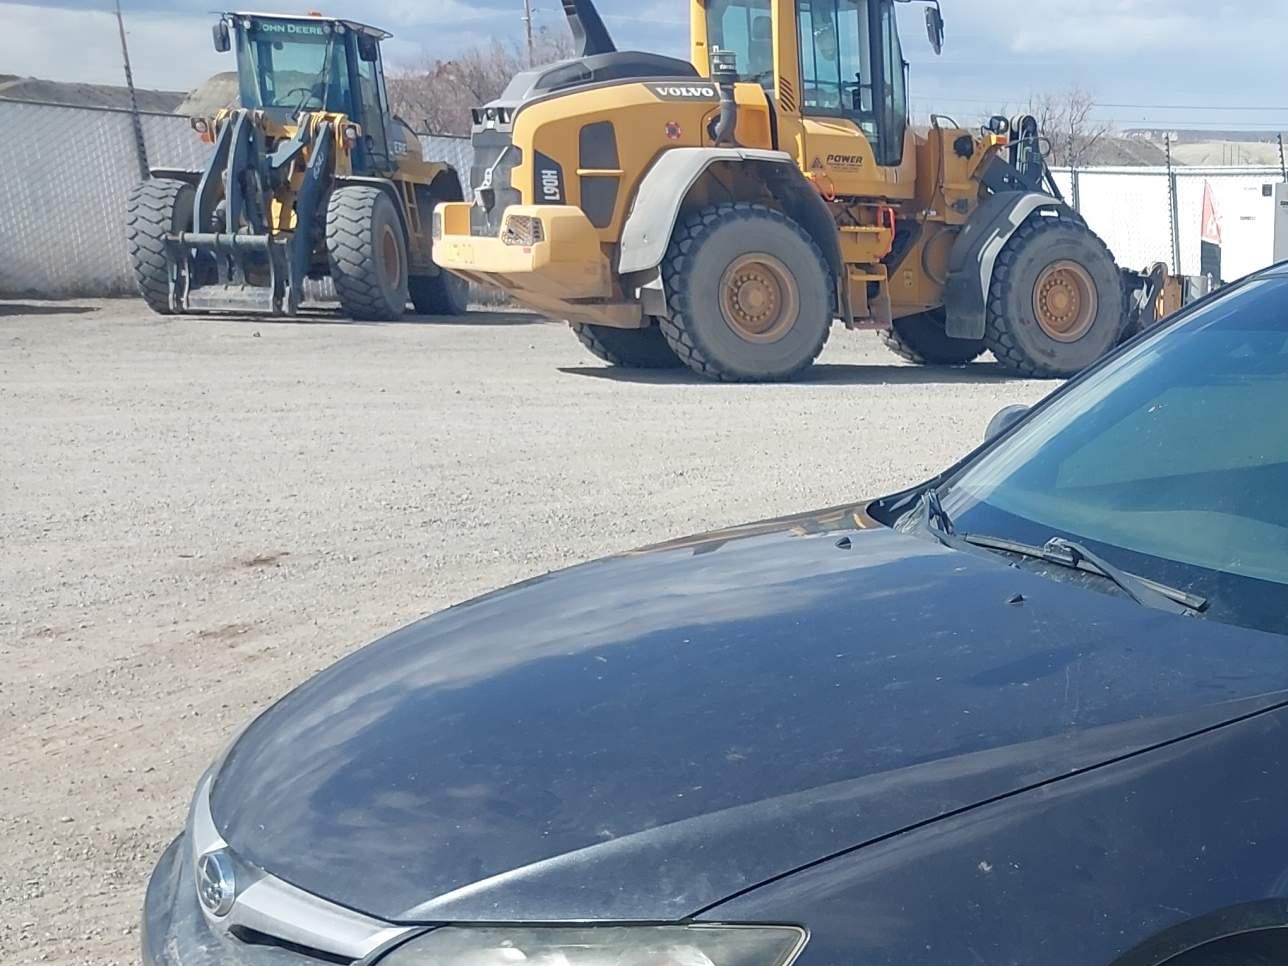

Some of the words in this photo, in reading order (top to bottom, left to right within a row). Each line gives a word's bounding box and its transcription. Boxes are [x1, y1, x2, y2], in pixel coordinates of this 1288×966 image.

[287, 24, 323, 35] DEERE
[655, 87, 714, 97] VOLVO
[826, 154, 863, 164] POWER
[541, 170, 560, 200] L90H
